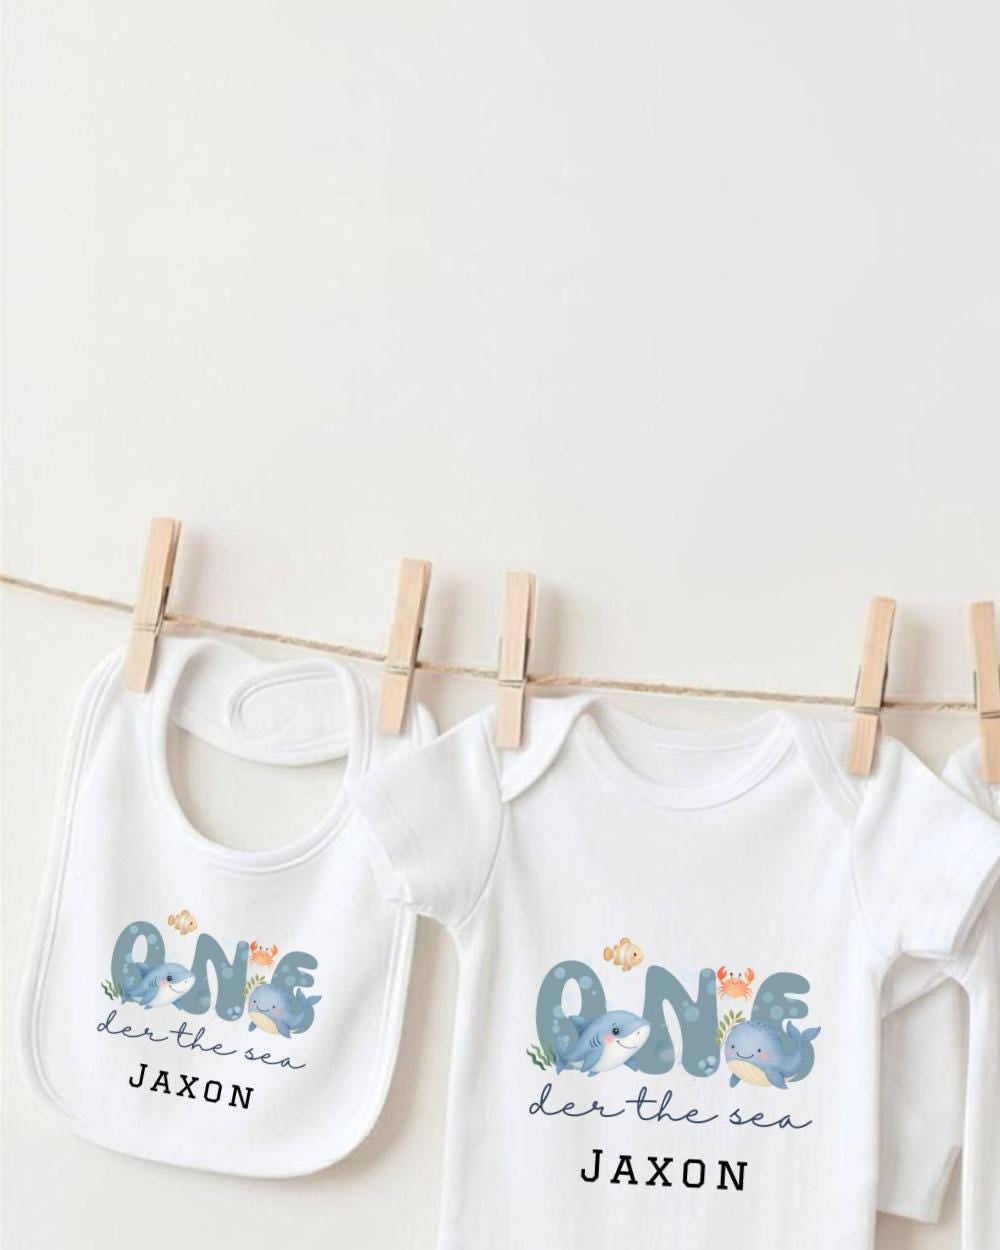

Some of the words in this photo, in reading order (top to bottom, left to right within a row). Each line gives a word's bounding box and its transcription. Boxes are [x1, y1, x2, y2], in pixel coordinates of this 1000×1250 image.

[111, 921, 318, 1034] ONE
[97, 1010, 169, 1042] der
[170, 1021, 237, 1056] the
[244, 1047, 306, 1070] sea
[535, 960, 815, 1083] ONE
[129, 1063, 254, 1109] JAXON
[528, 1083, 625, 1117] der
[625, 1086, 719, 1124] the
[728, 1108, 813, 1129] sea
[580, 1148, 748, 1191] JAXON
